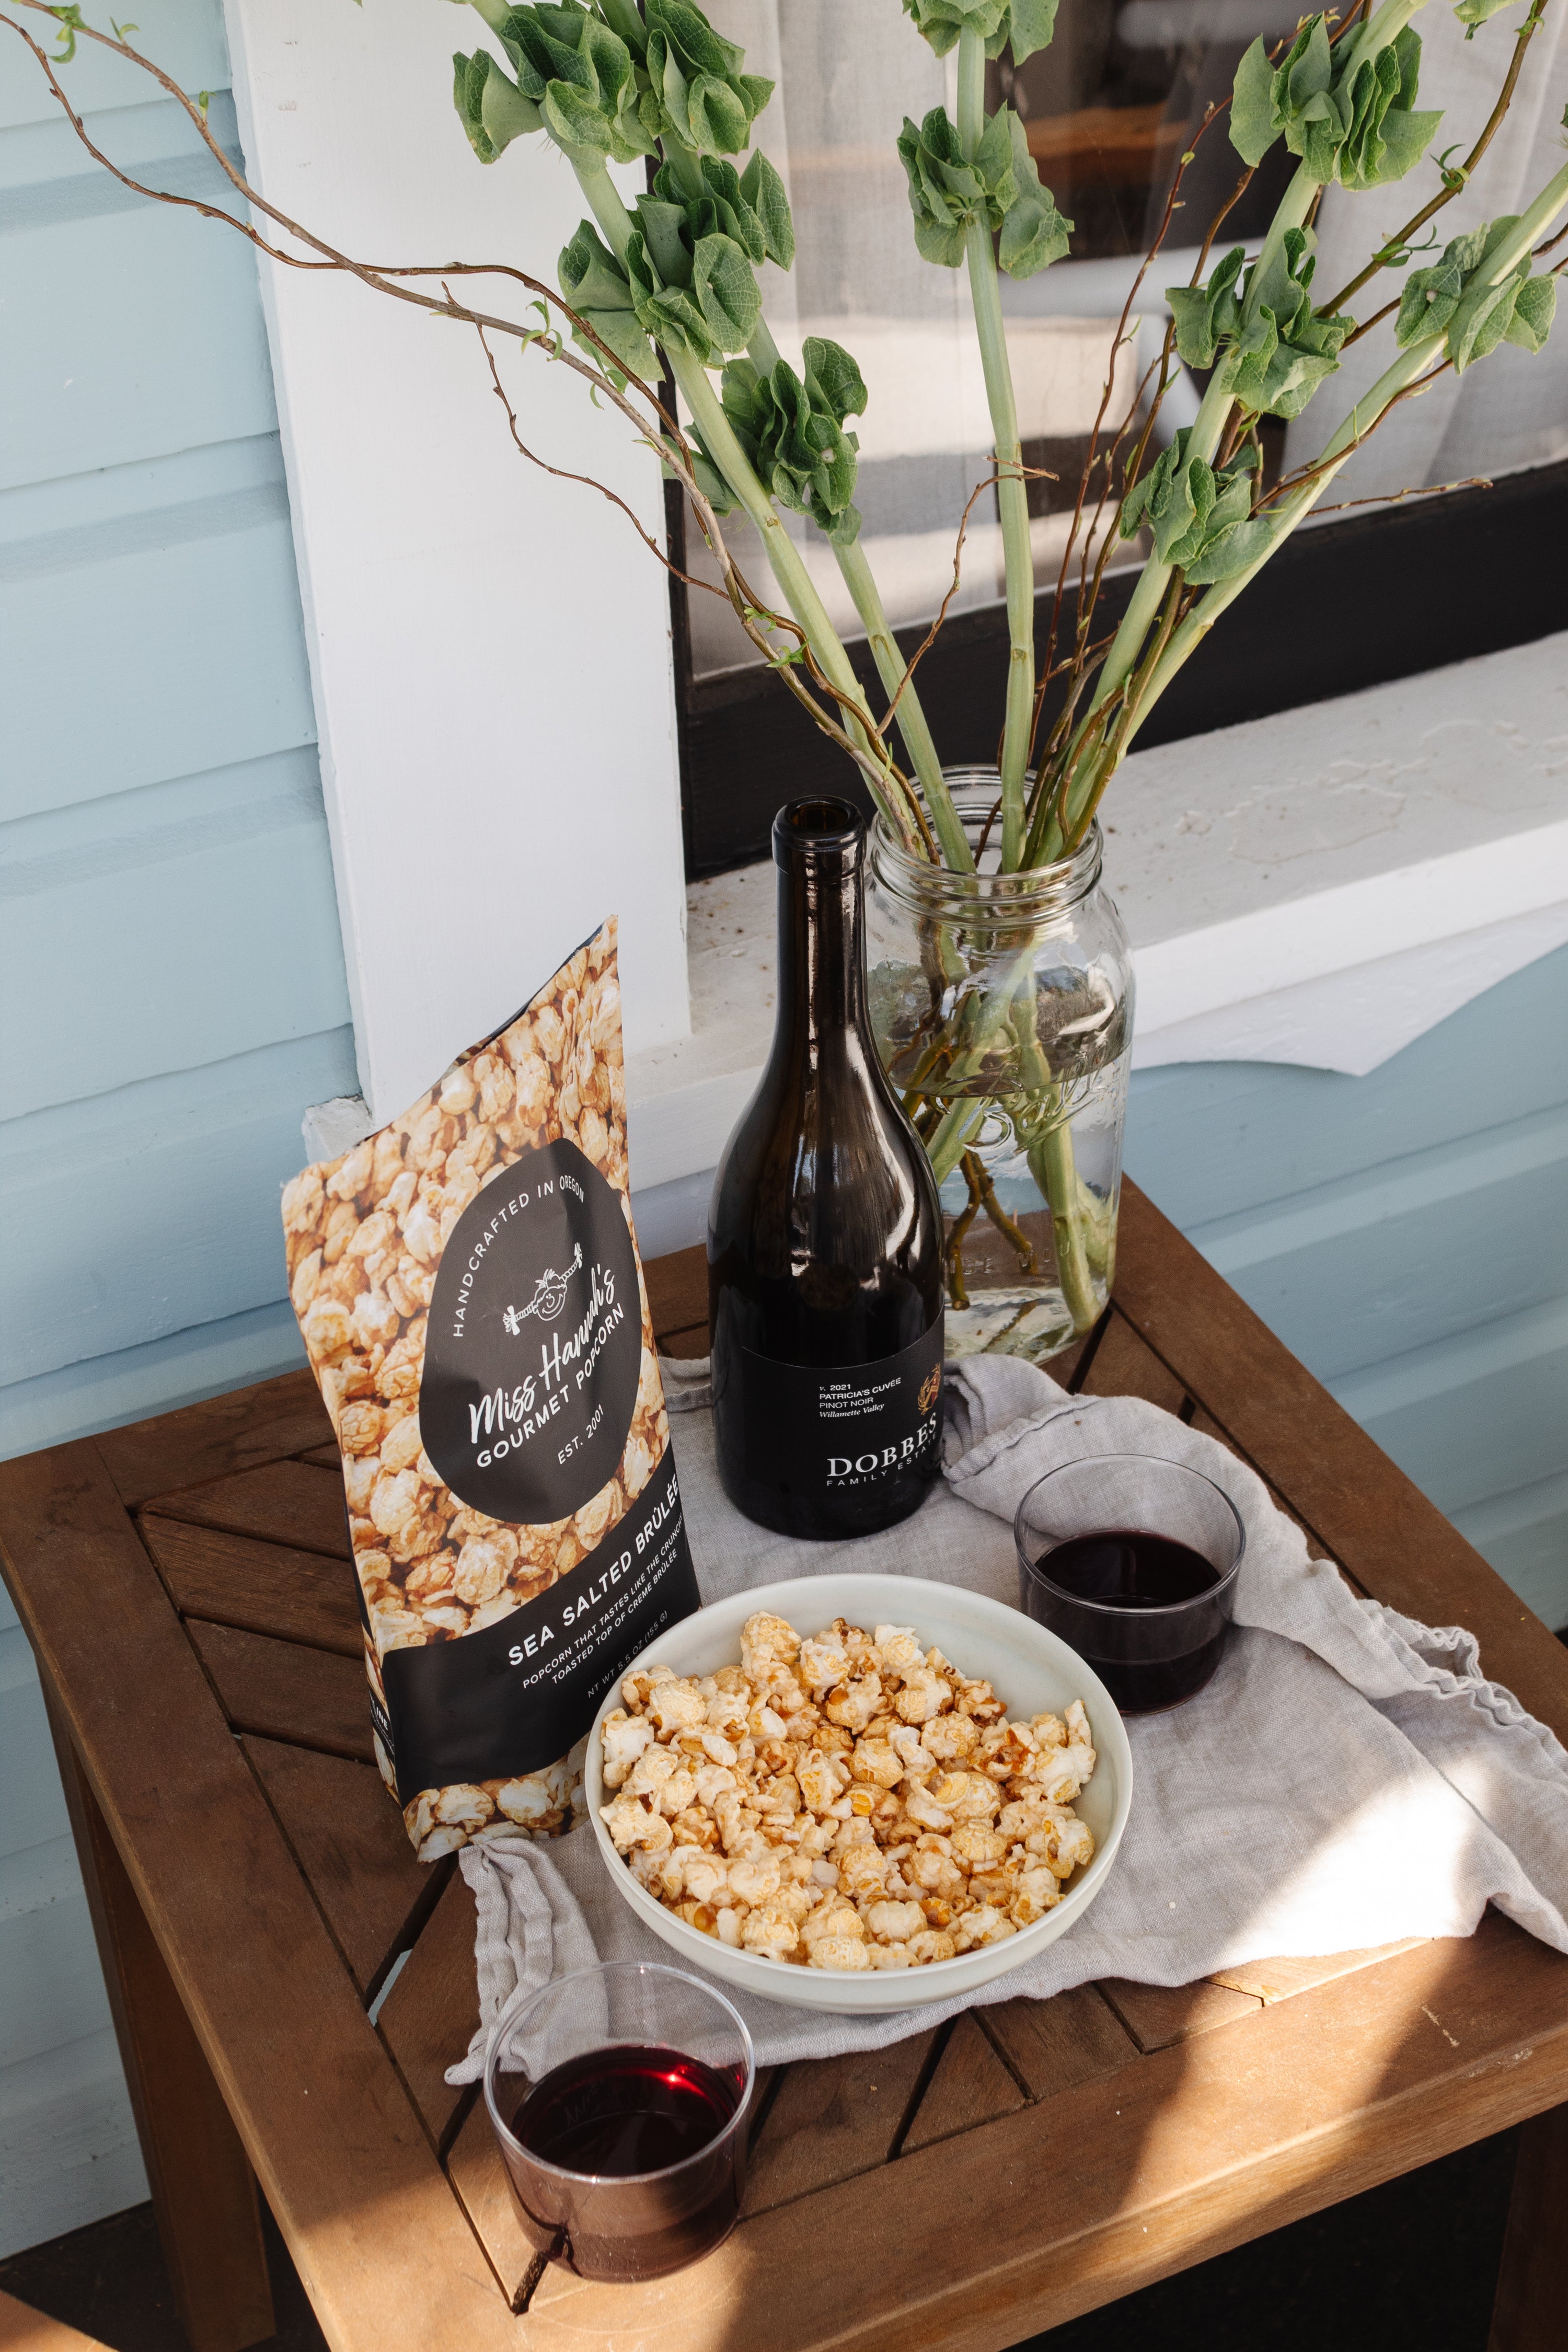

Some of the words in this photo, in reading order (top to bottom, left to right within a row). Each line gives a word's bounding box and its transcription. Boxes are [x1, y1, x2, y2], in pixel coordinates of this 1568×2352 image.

[453, 1192, 530, 1337] HANDCRAFTED
[537, 1180, 554, 1198] IN
[559, 1174, 584, 1203] OREGON
[468, 1375, 536, 1445] Miss
[477, 1384, 569, 1468] GOURMET
[575, 1302, 625, 1390] POPCORN
[819, 1389, 870, 1400] PATRICIA'S
[872, 1377, 902, 1393] CUVÉE
[819, 1409, 861, 1418] Willamette
[863, 1403, 885, 1414] Valley
[850, 1397, 874, 1408] NOIR
[557, 1433, 584, 1465] EST.
[585, 1403, 604, 1439] 2001
[826, 1412, 937, 1477] DOBBES
[826, 1470, 887, 1486] FAMILY
[509, 1625, 555, 1666] SEA
[562, 1551, 631, 1627] SALTED
[635, 1473, 679, 1555] BRÛLÉE
[523, 1646, 572, 1689] POPCORN
[574, 1624, 597, 1650] THAT
[599, 1593, 629, 1626] TASTES
[630, 1572, 646, 1596] LIKE
[645, 1553, 661, 1575] THE
[551, 1644, 594, 1684] TOASTED
[595, 1625, 613, 1646] TOP
[614, 1611, 626, 1628] OF
[627, 1582, 653, 1614] CREME
[653, 1549, 678, 1585] BRÛLÉE
[587, 1682, 600, 1699] NT
[602, 1668, 616, 1685] WT
[618, 1653, 631, 1671] 5.5
[632, 1640, 643, 1655] OZ
[644, 1621, 659, 1643] (155
[660, 1610, 668, 1623] G)
